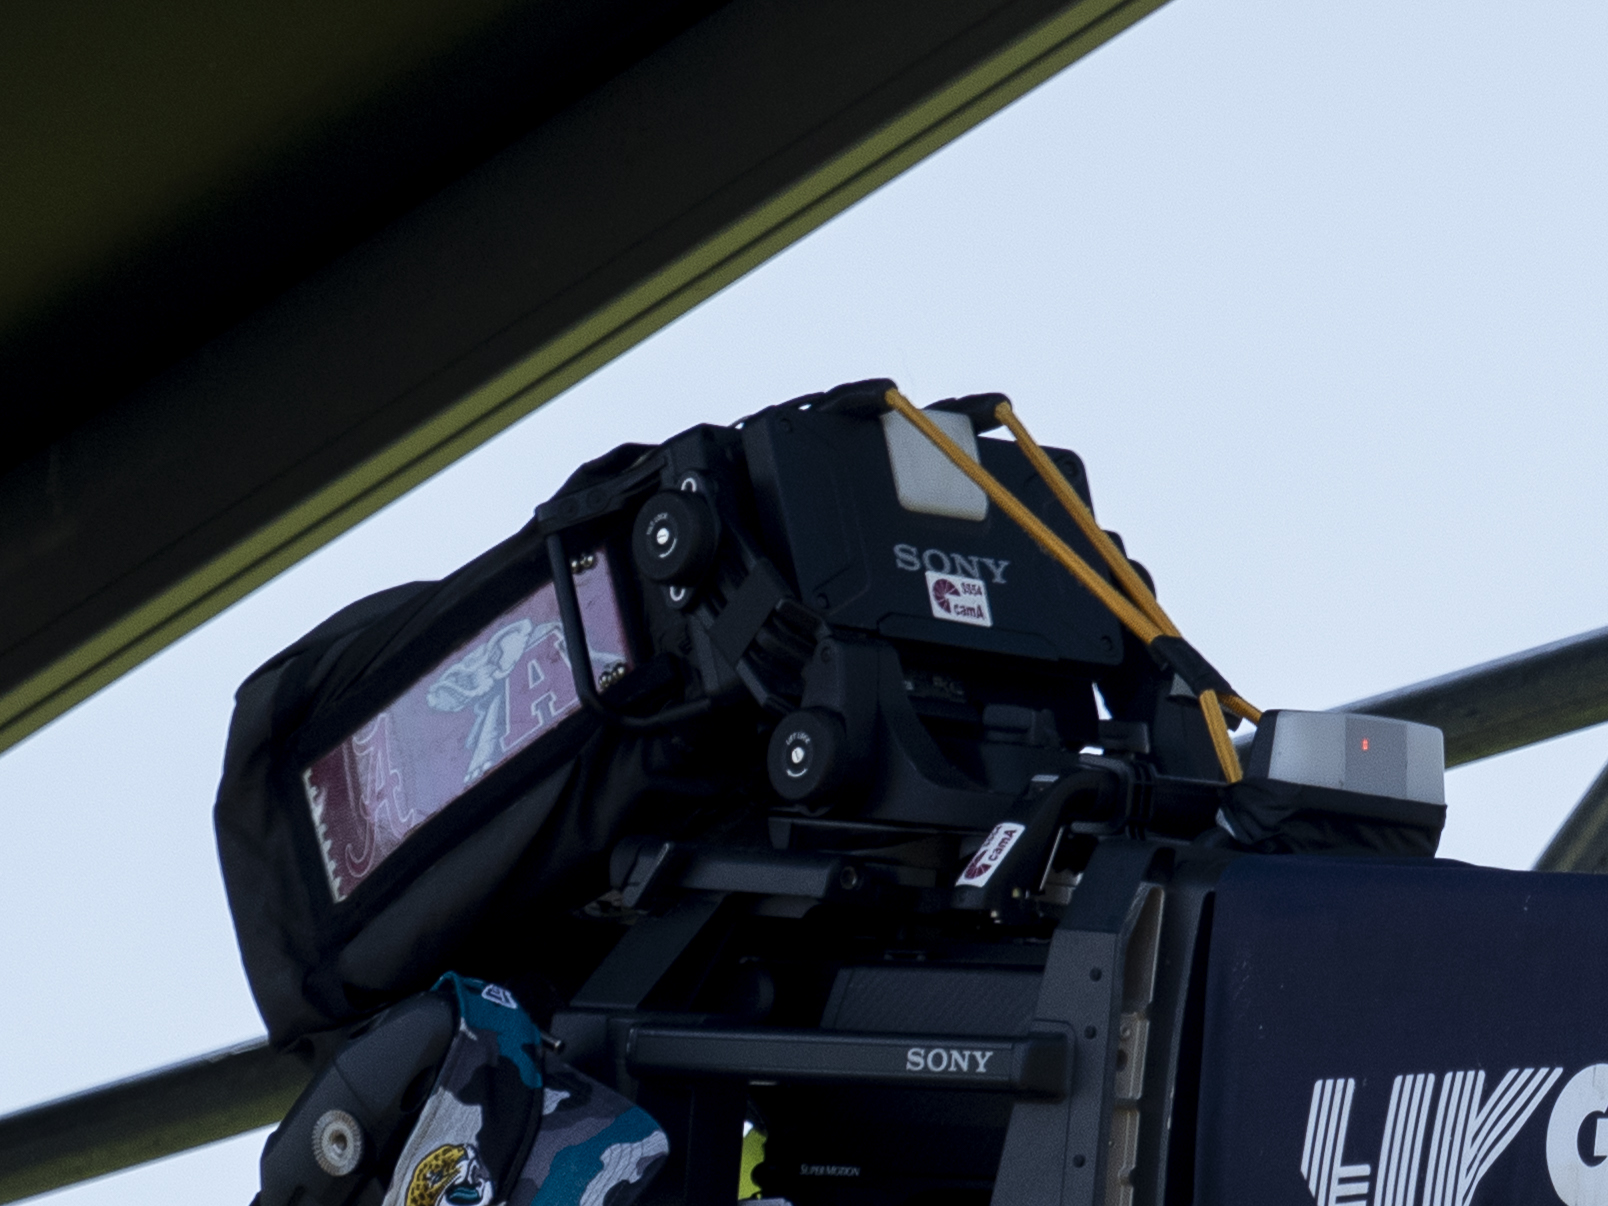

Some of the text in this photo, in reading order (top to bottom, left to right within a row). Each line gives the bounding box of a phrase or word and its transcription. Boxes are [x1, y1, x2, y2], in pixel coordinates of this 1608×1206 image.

[893, 544, 1010, 584] SONY
[954, 604, 985, 619] camA
[989, 829, 1017, 861] camA
[905, 1048, 993, 1073] SONY
